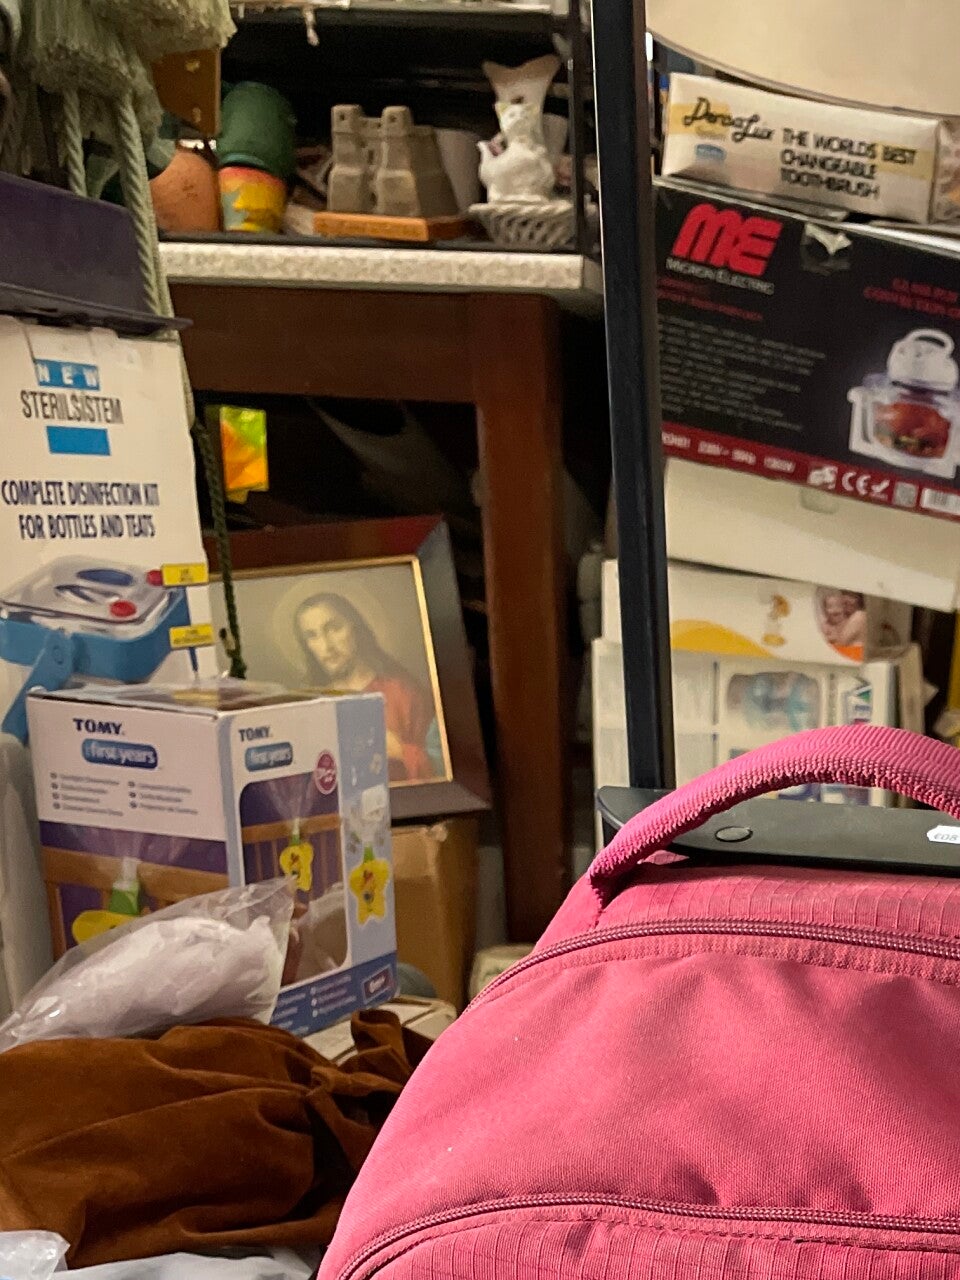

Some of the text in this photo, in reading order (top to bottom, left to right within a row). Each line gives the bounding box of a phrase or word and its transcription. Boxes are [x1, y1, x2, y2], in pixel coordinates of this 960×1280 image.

[782, 128, 810, 147] THE
[882, 145, 917, 165] BEST
[781, 149, 877, 180] CHANGEABLE
[781, 167, 880, 199] TOOTHBRUSH
[35, 361, 98, 387] NEW
[20, 389, 124, 425] STERILSISTEM
[1, 479, 160, 507] COMPLETE DISINFECTION KIT
[18, 513, 156, 539] FOR BOTTLES AND TEATS
[73, 718, 123, 735] TOMY
[238, 726, 271, 741] TOMY
